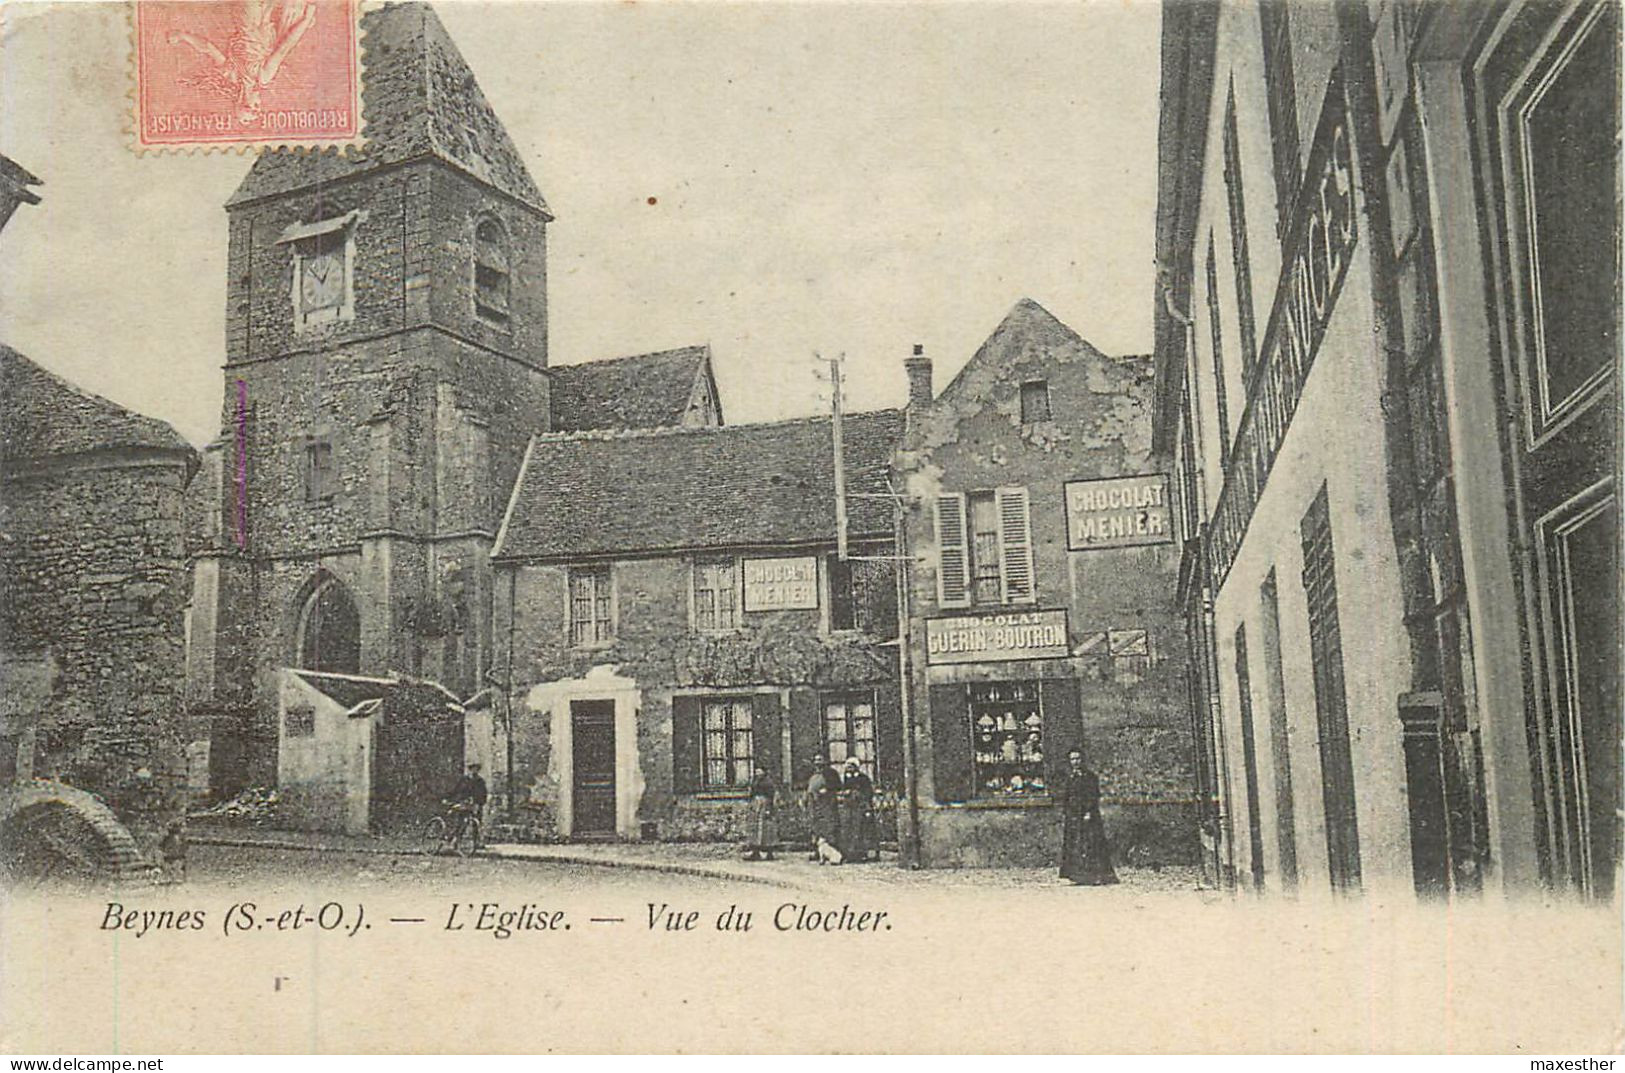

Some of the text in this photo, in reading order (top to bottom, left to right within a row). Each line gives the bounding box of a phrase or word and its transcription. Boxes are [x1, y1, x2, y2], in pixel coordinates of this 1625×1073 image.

[1072, 484, 1164, 513] CHOCOLAT
[1077, 511, 1164, 541] MENIER
[949, 612, 1043, 629] CHOCOLAT
